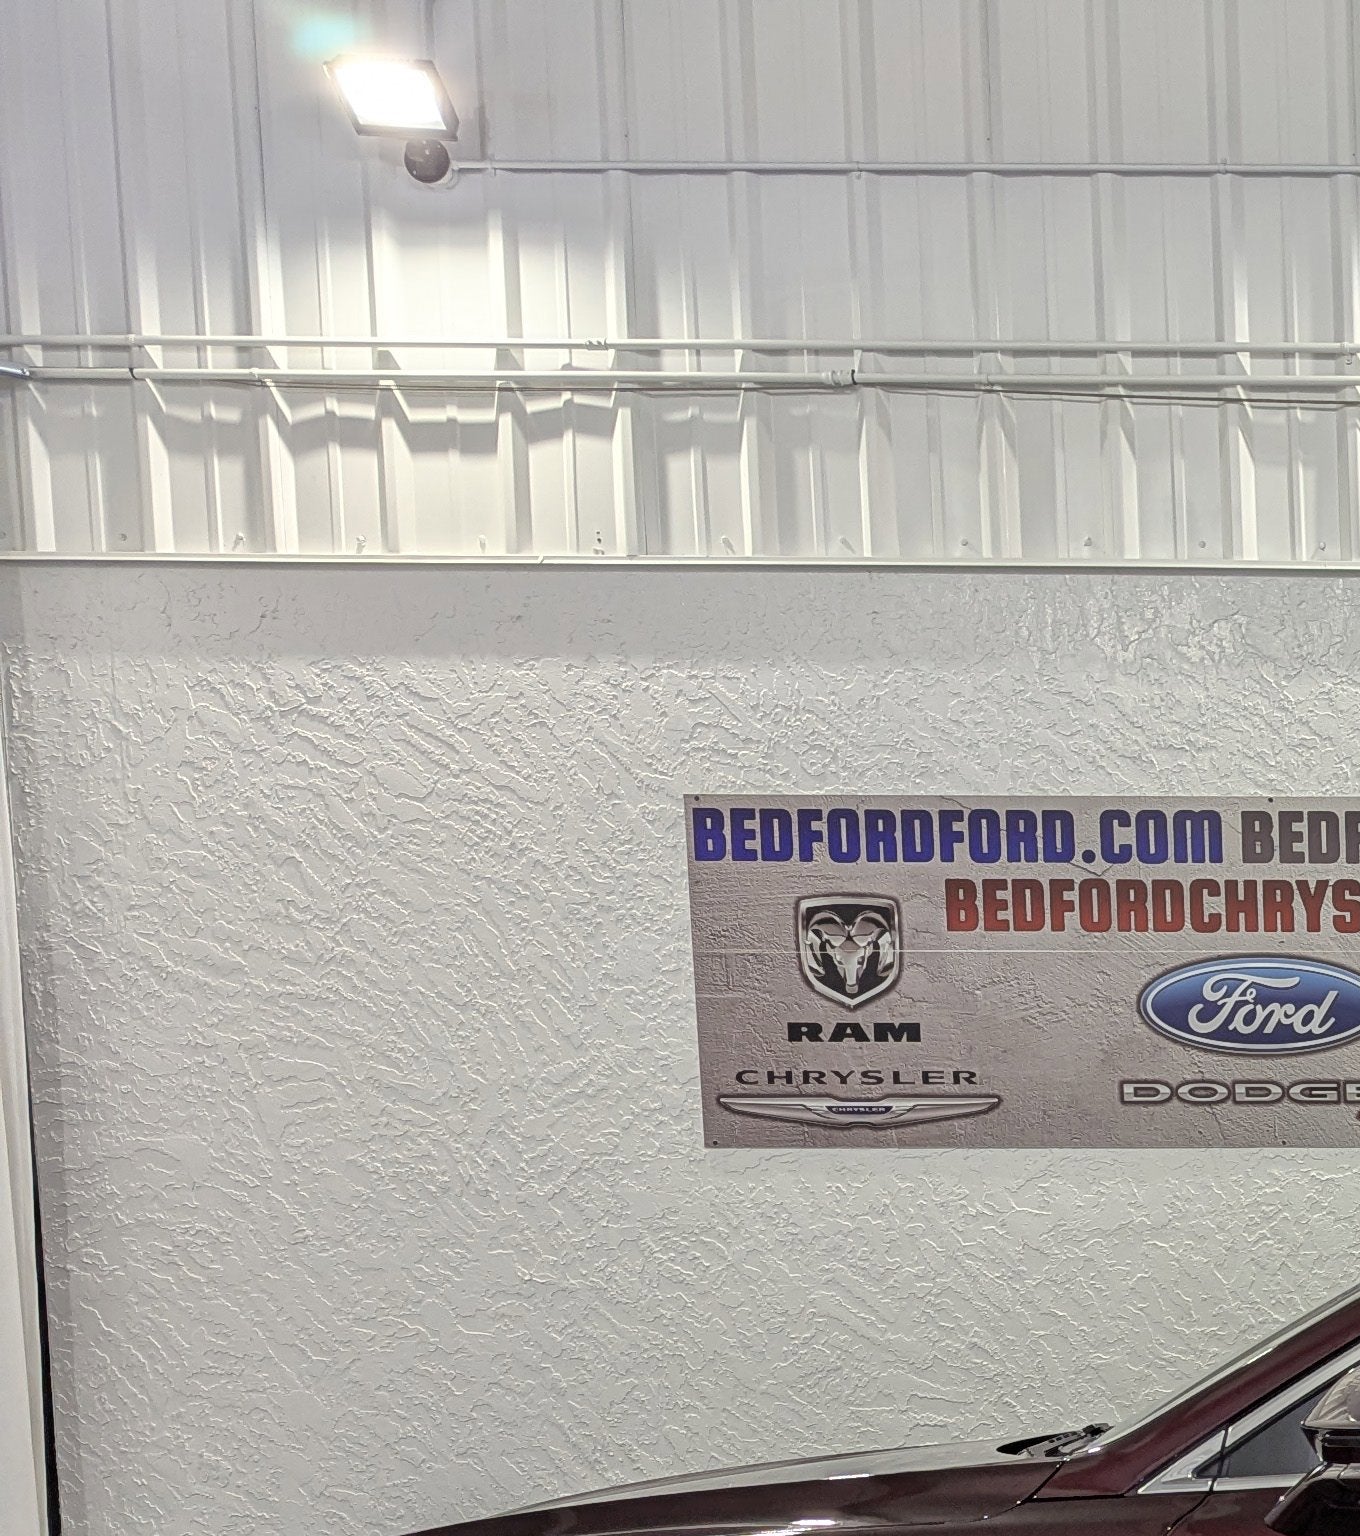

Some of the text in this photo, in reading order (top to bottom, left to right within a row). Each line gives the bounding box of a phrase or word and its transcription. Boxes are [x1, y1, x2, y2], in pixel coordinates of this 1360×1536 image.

[692, 807, 1224, 864] BEDFORDFORD.COM
[1188, 973, 1337, 1035] Ford
[787, 1022, 922, 1043] RAM
[735, 1069, 979, 1086] CHRYSLER
